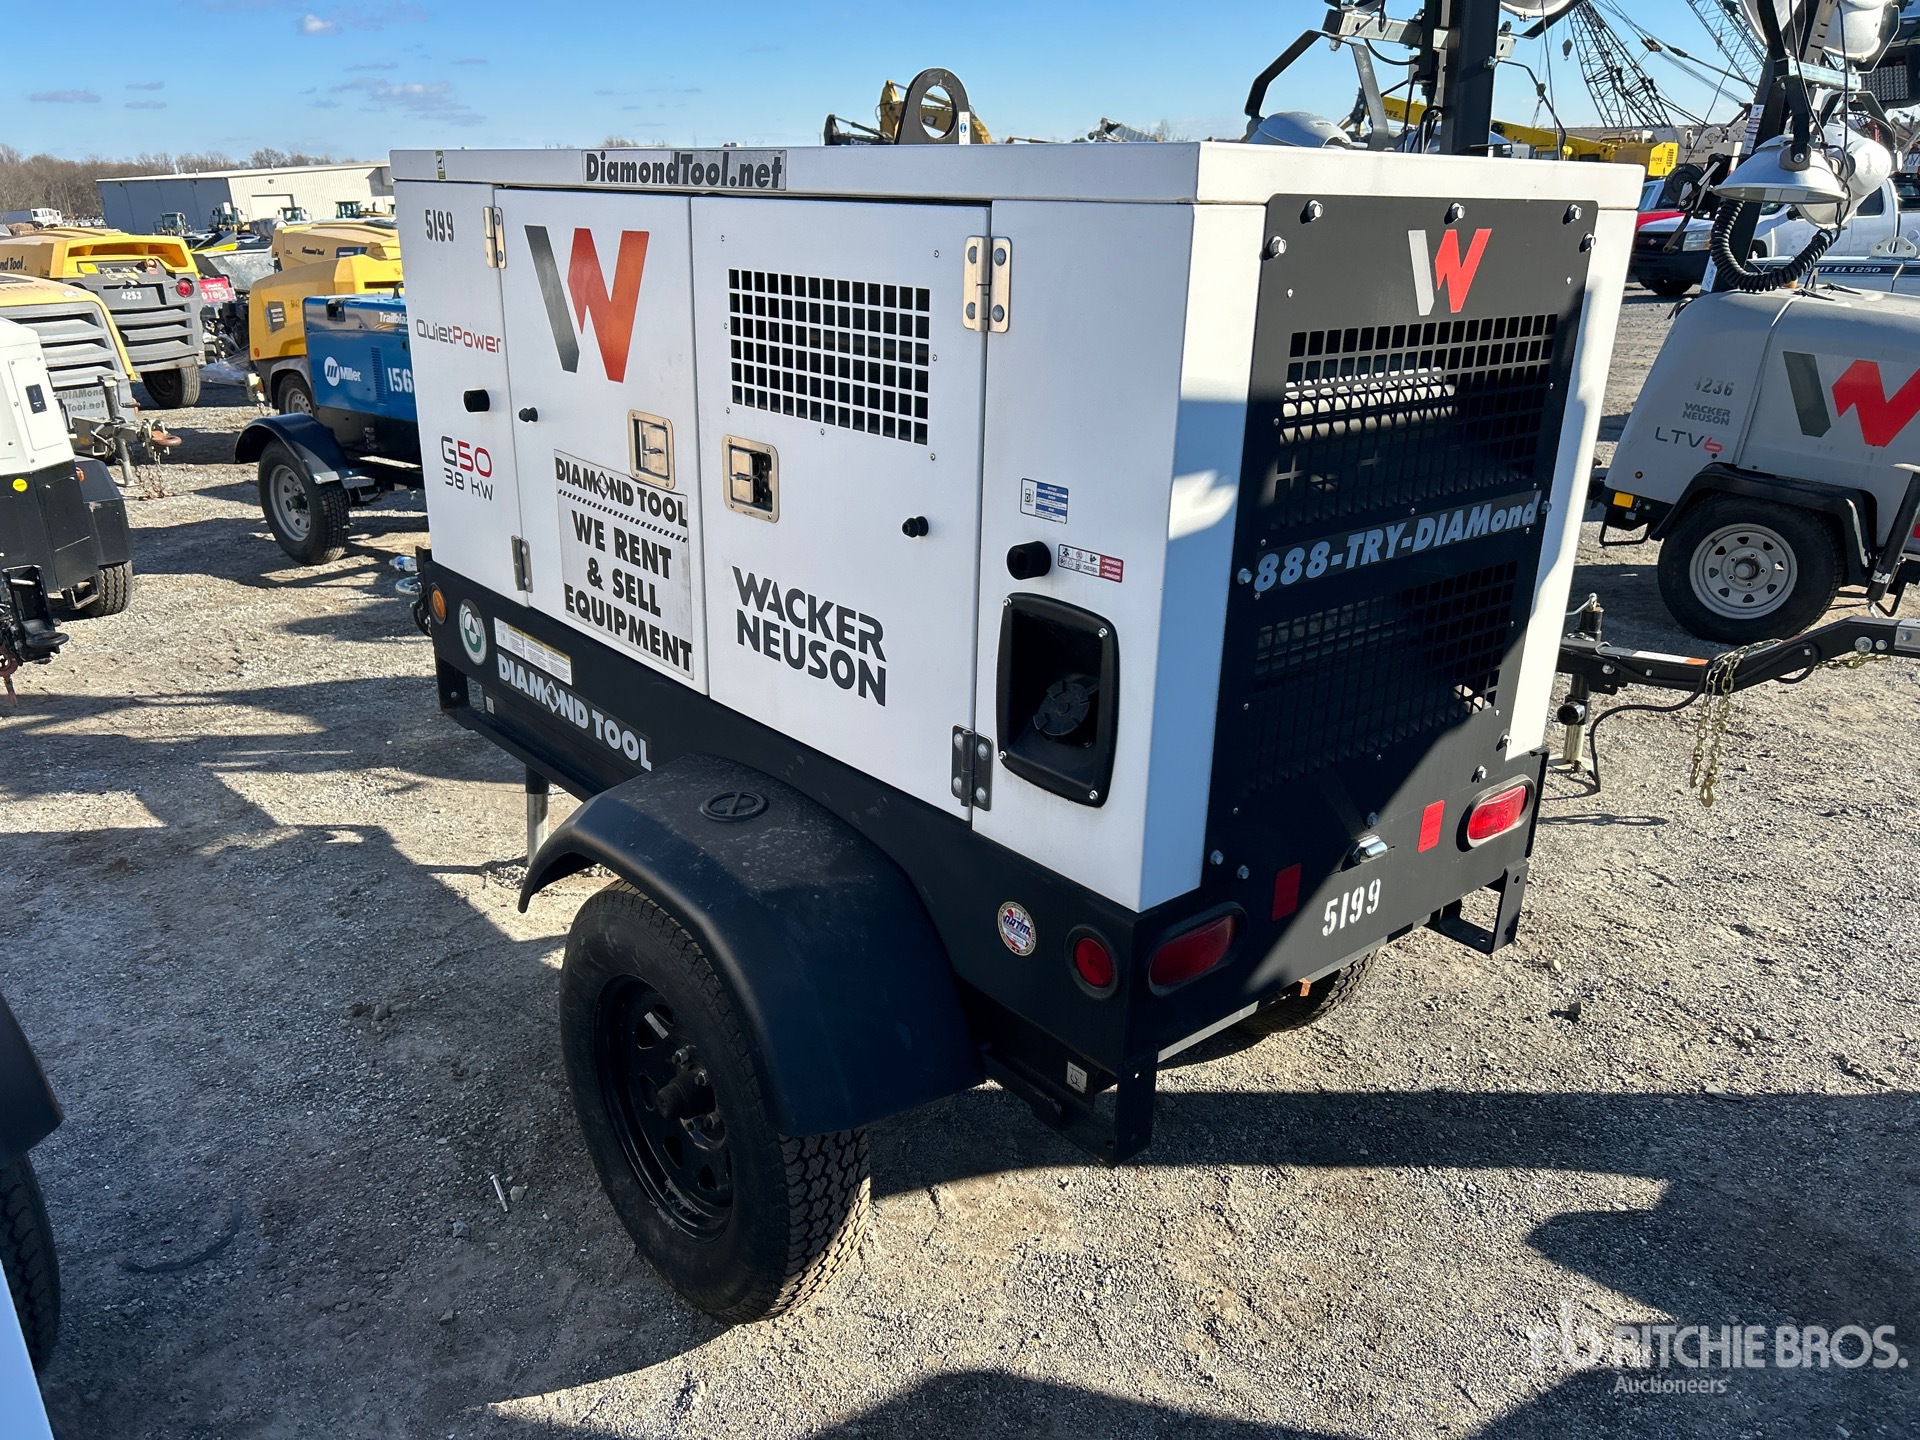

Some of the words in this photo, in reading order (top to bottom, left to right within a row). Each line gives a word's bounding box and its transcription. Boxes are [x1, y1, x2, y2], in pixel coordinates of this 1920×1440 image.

[586, 151, 783, 189] DiamondTool.net
[425, 209, 455, 242] 5199
[10, 255, 24, 270] Tool
[121, 291, 142, 300] 4253
[416, 319, 501, 353] QuietPower
[67, 400, 105, 412] Tool.net
[1682, 410, 1731, 426] NEUSON
[1684, 402, 1731, 418] WACKER
[441, 436, 493, 478] G50
[1655, 426, 1723, 453] LTV6
[444, 467, 465, 491] 38
[637, 487, 688, 528] TOOL
[571, 509, 606, 553] WE
[613, 527, 672, 580] RENT
[1253, 490, 1542, 592] 888-TRY-DIAMond
[587, 557, 604, 591] &
[612, 568, 662, 618] SELL
[564, 582, 692, 673] EQUIPMENT
[731, 565, 887, 663] WACKER
[736, 608, 887, 707] NEUSON
[592, 708, 652, 772] TOOL
[1322, 878, 1381, 937] 5199
